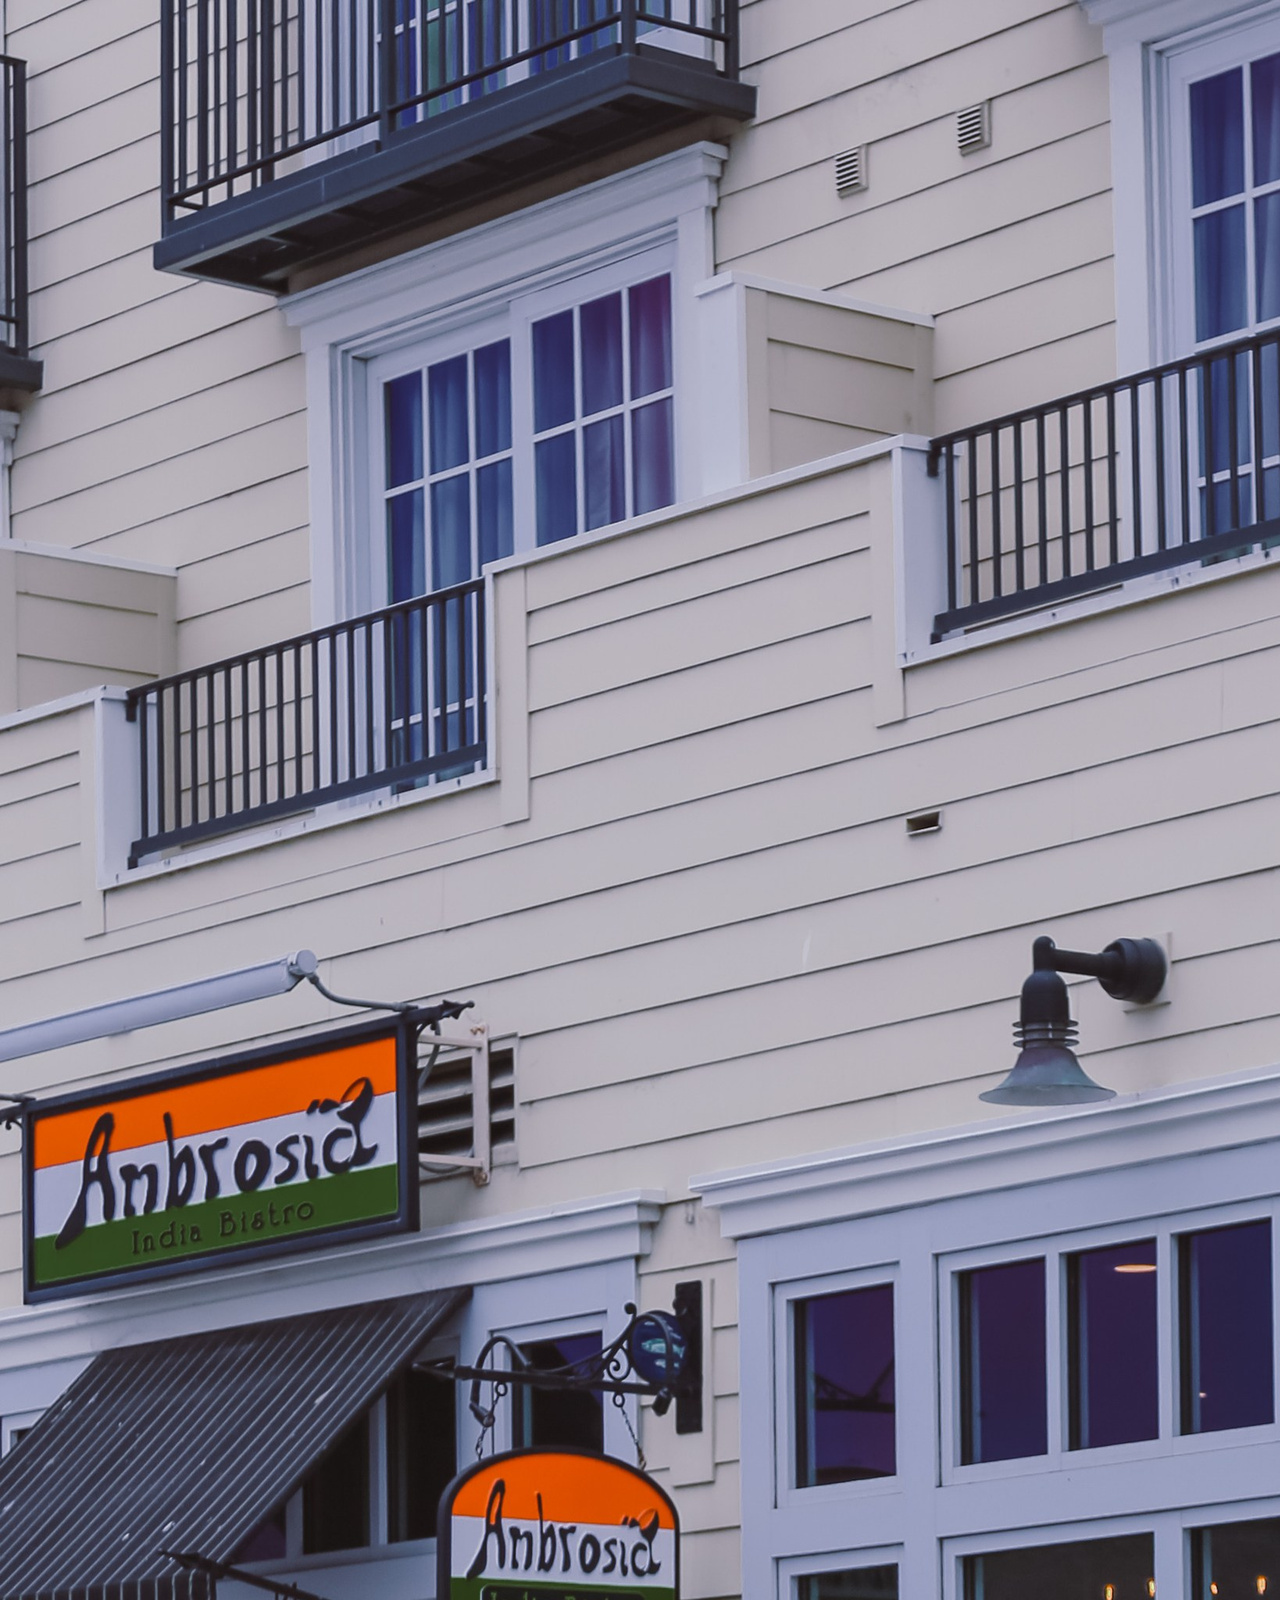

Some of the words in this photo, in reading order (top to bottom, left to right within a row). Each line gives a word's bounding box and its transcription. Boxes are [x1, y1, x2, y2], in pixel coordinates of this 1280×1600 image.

[55, 1076, 378, 1250] Ambrosia
[131, 1220, 202, 1255] India
[219, 1200, 315, 1237] Bistro
[466, 1477, 661, 1580] Ambrosia
